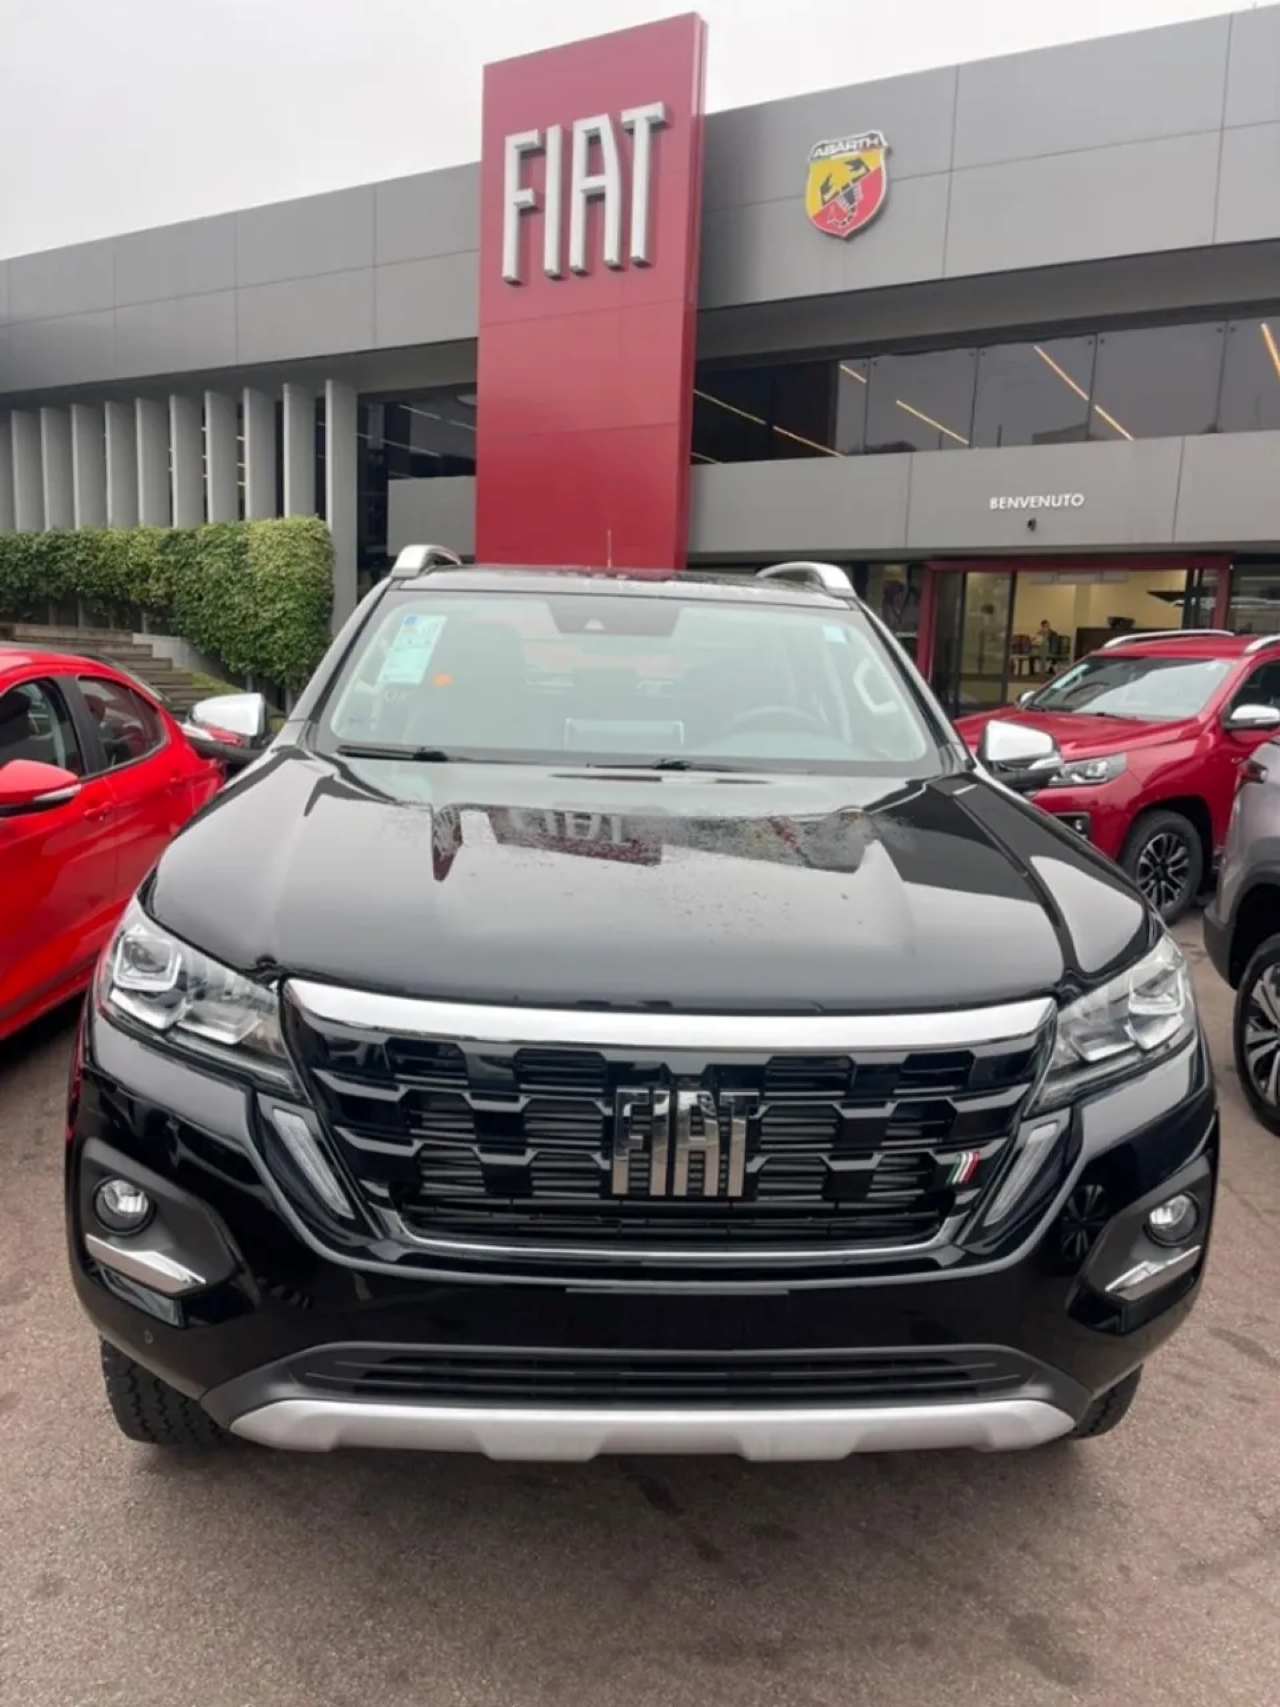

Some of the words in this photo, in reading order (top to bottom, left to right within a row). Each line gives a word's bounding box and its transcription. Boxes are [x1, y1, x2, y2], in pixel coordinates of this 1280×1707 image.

[813, 137, 880, 158] ABARTH
[502, 101, 665, 282] FIAT
[989, 493, 1085, 510] BENVENUTO
[612, 1088, 760, 1197] FIAT
